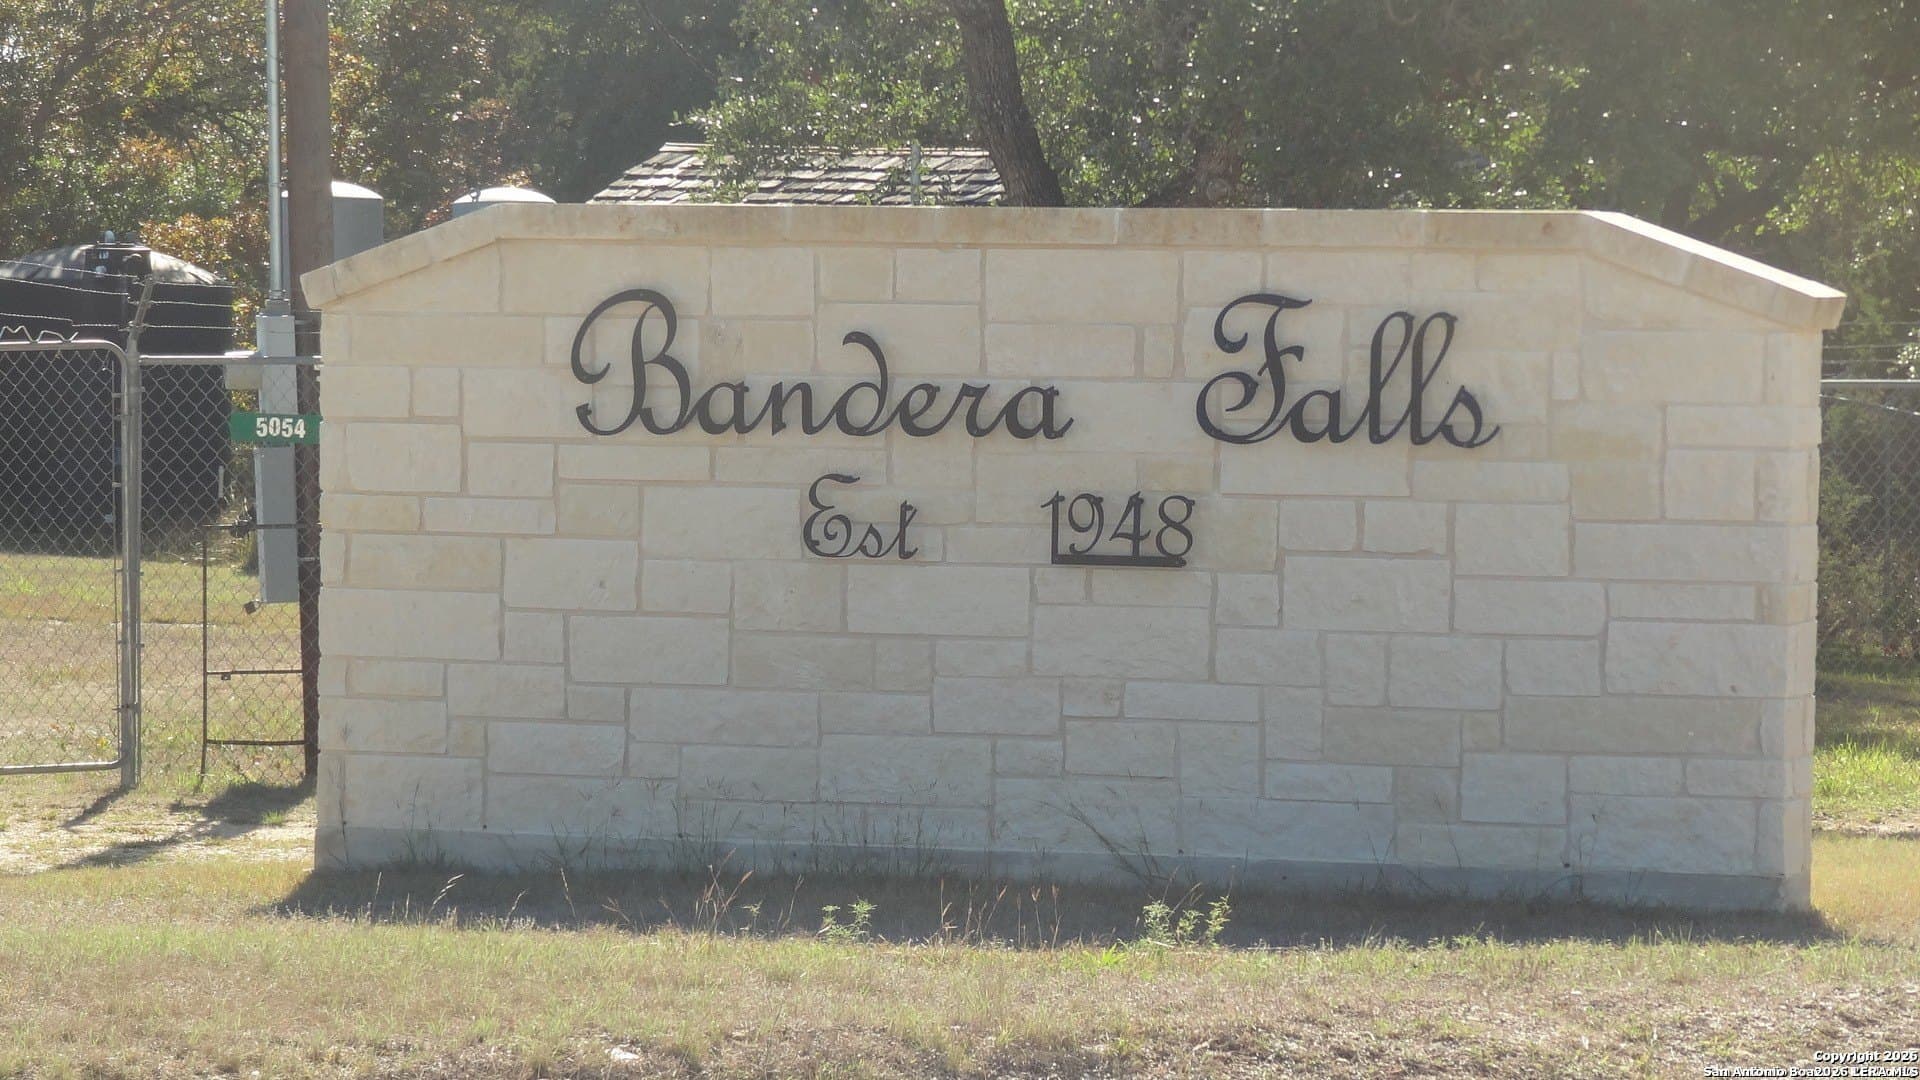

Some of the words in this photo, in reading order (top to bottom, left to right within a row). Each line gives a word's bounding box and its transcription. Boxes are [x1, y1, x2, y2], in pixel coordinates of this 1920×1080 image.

[571, 289, 1074, 439] Bandera
[1196, 293, 1500, 448] Falls
[256, 417, 306, 438] 5054
[803, 474, 918, 559] Est
[1041, 491, 1195, 566] 1948
